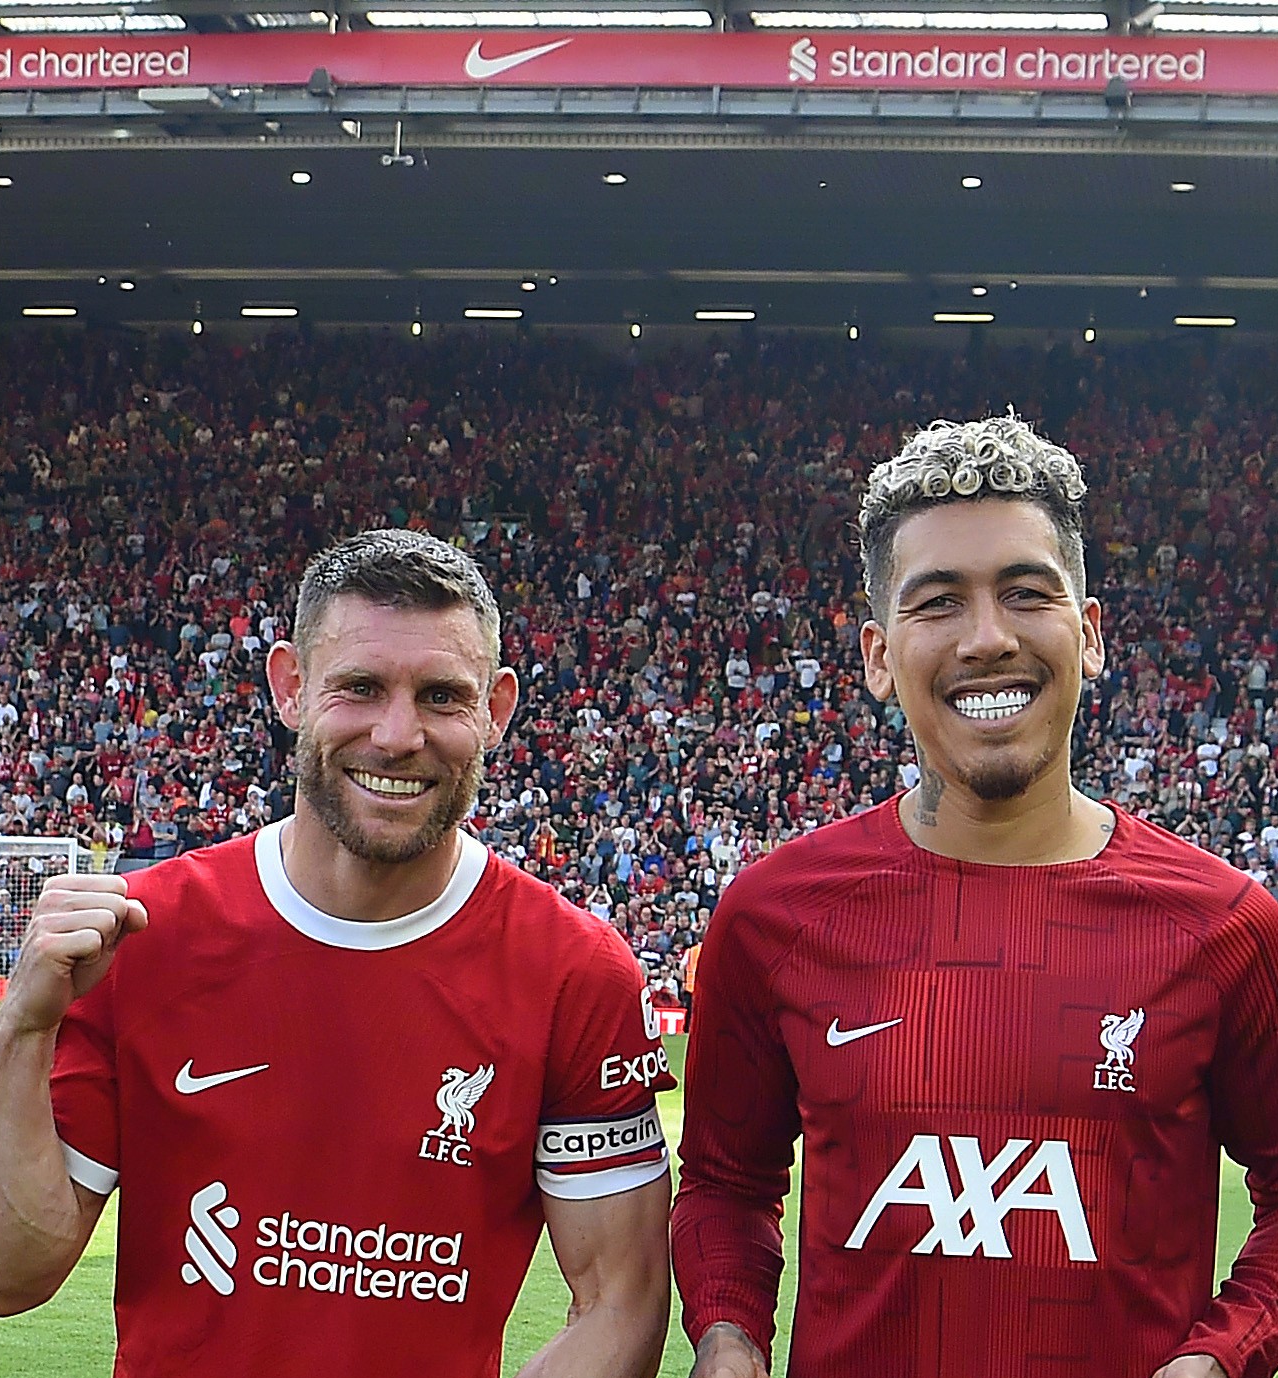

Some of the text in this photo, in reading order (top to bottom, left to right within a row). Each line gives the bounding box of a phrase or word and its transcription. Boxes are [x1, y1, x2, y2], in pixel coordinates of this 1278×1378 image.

[21, 46, 190, 78] chartered
[830, 45, 1206, 81] standard chartered
[542, 1117, 658, 1158] Captain
[844, 1134, 1098, 1262] AXA
[256, 1211, 463, 1267] standard
[253, 1248, 470, 1303] chartered
